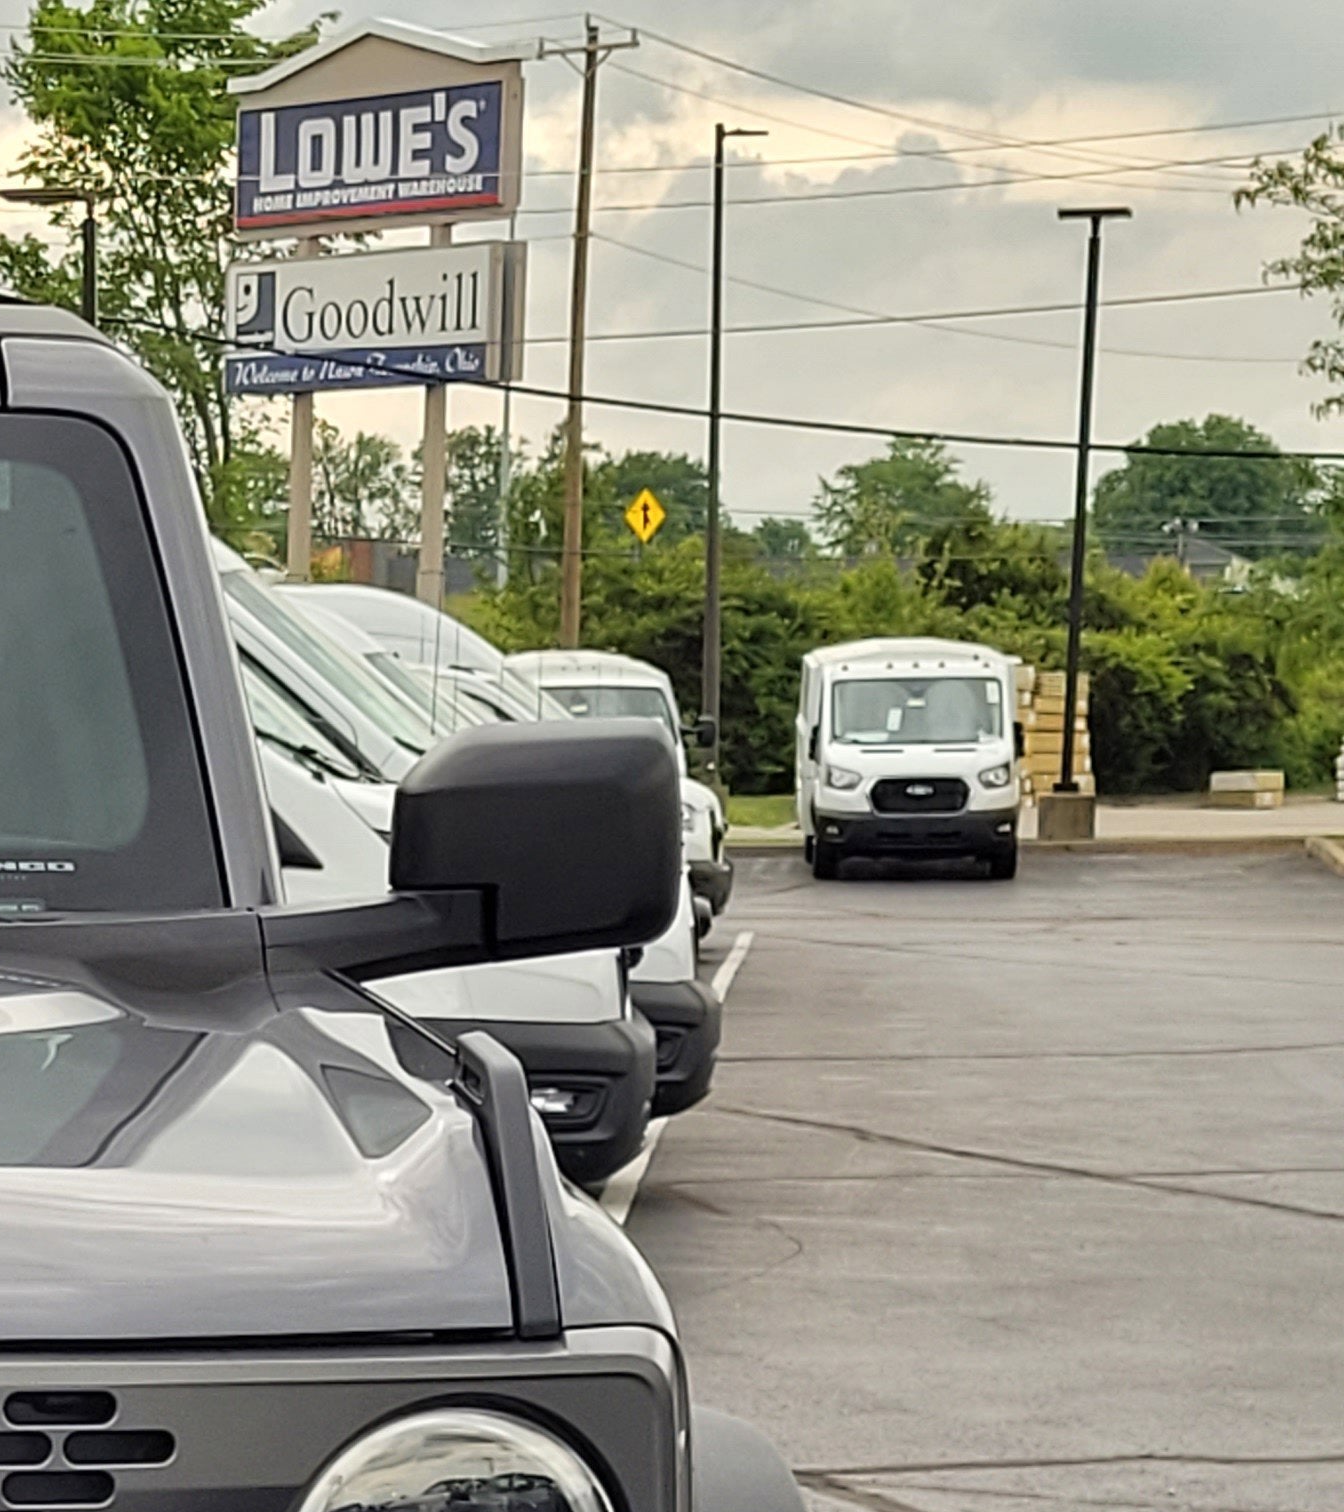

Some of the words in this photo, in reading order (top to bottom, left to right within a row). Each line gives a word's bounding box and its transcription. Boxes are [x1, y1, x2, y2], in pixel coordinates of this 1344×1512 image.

[259, 91, 480, 193] LOWE'S
[252, 193, 294, 214] HOME
[295, 182, 395, 209] IMPROVEMENT
[397, 173, 484, 199] WAREHOUSE
[281, 270, 481, 344] Goodwill
[234, 361, 299, 387] Welcome
[301, 365, 316, 383] to
[444, 346, 481, 374] Ohio
